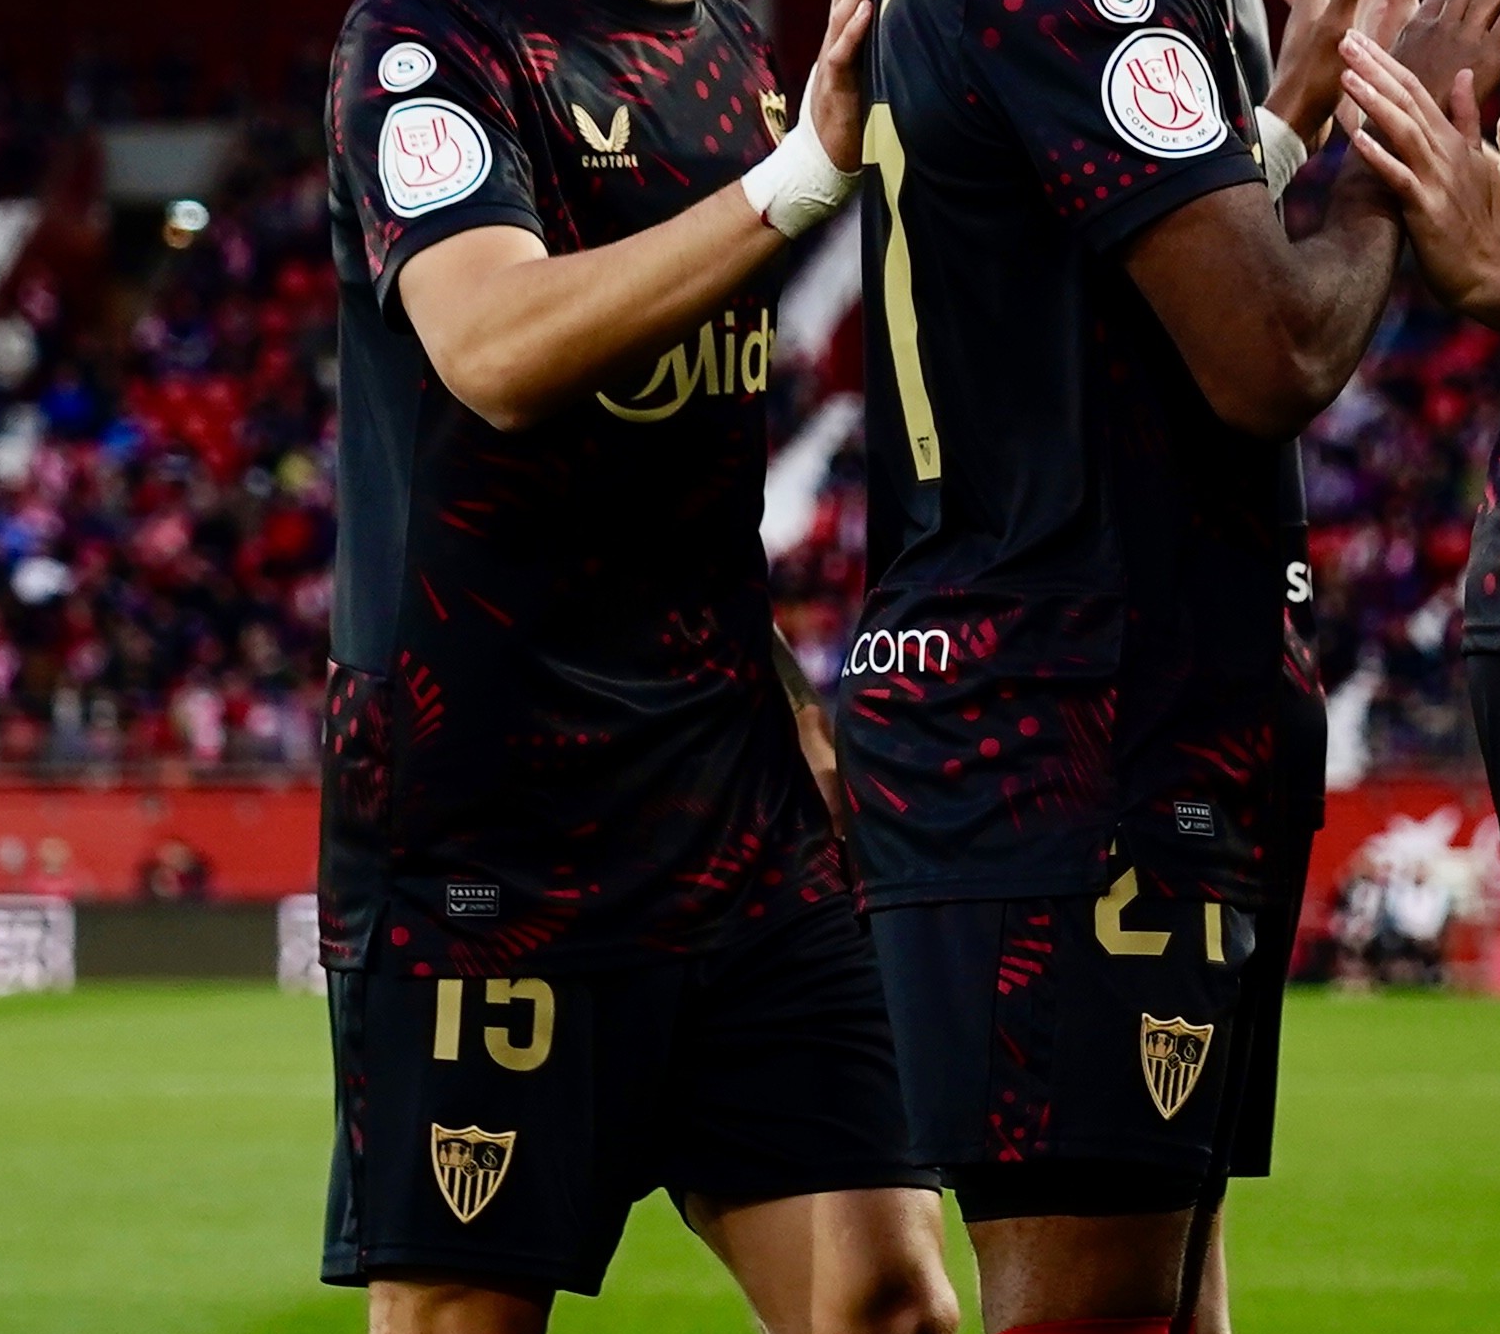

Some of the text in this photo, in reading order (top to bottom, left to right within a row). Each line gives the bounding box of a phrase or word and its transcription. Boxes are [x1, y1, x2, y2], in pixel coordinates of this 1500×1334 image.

[1125, 107, 1155, 139] COPA
[596, 307, 777, 423] Mid
[433, 978, 556, 1071] 15
